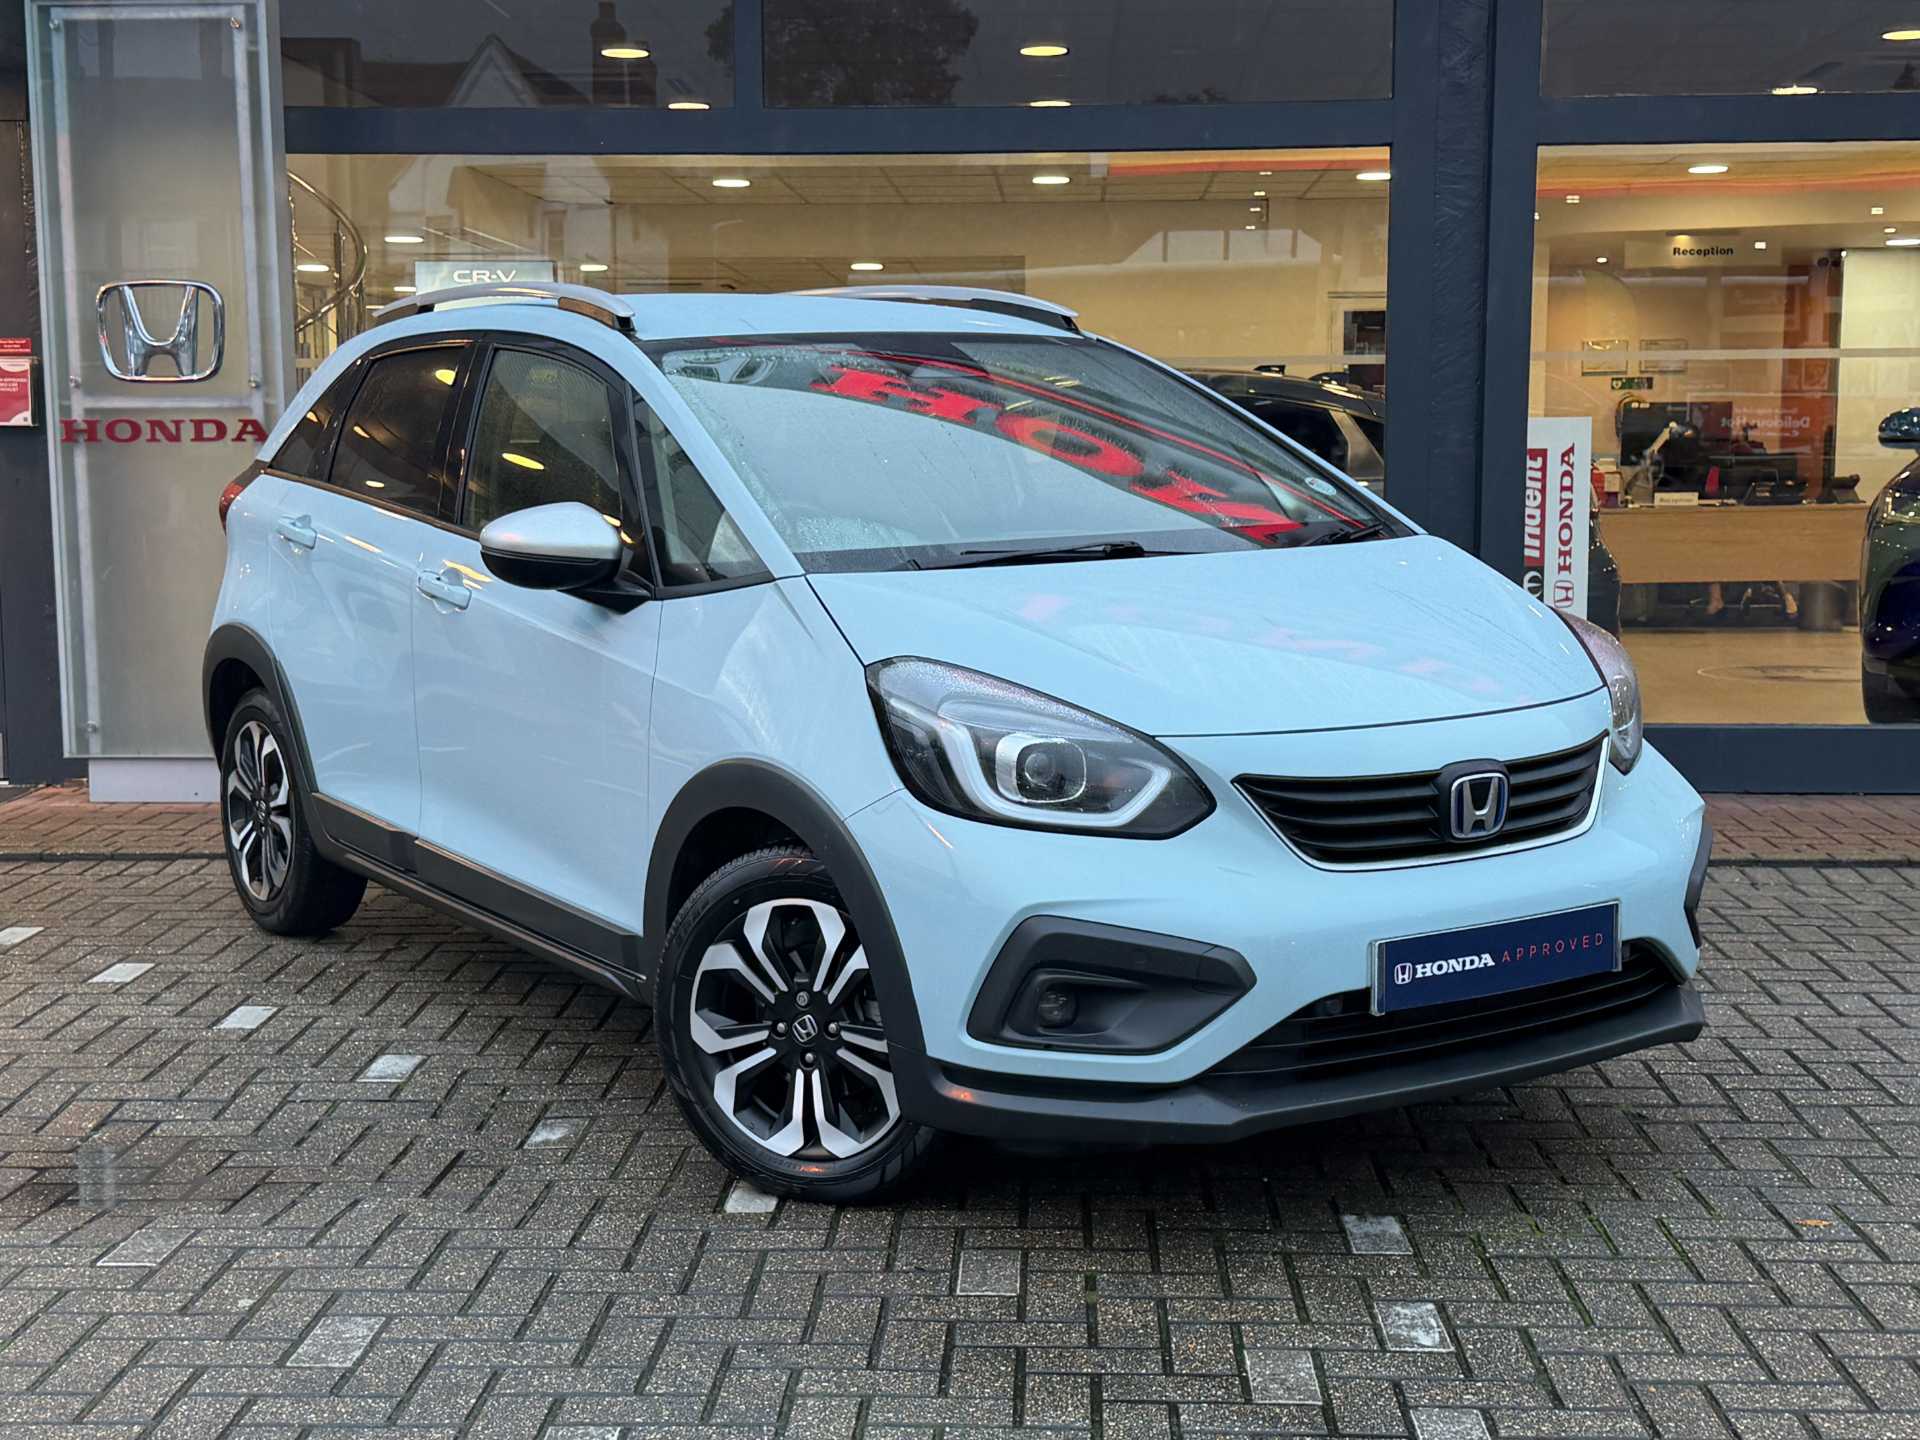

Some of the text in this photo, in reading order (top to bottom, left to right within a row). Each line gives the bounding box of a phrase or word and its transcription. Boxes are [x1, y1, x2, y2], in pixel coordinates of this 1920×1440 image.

[1672, 246, 1734, 257] Reception
[452, 269, 517, 283] CR-V
[60, 418, 269, 443] HONDA
[1557, 441, 1576, 575] HONDA
[1414, 932, 1604, 979] HONDA APPROVED
